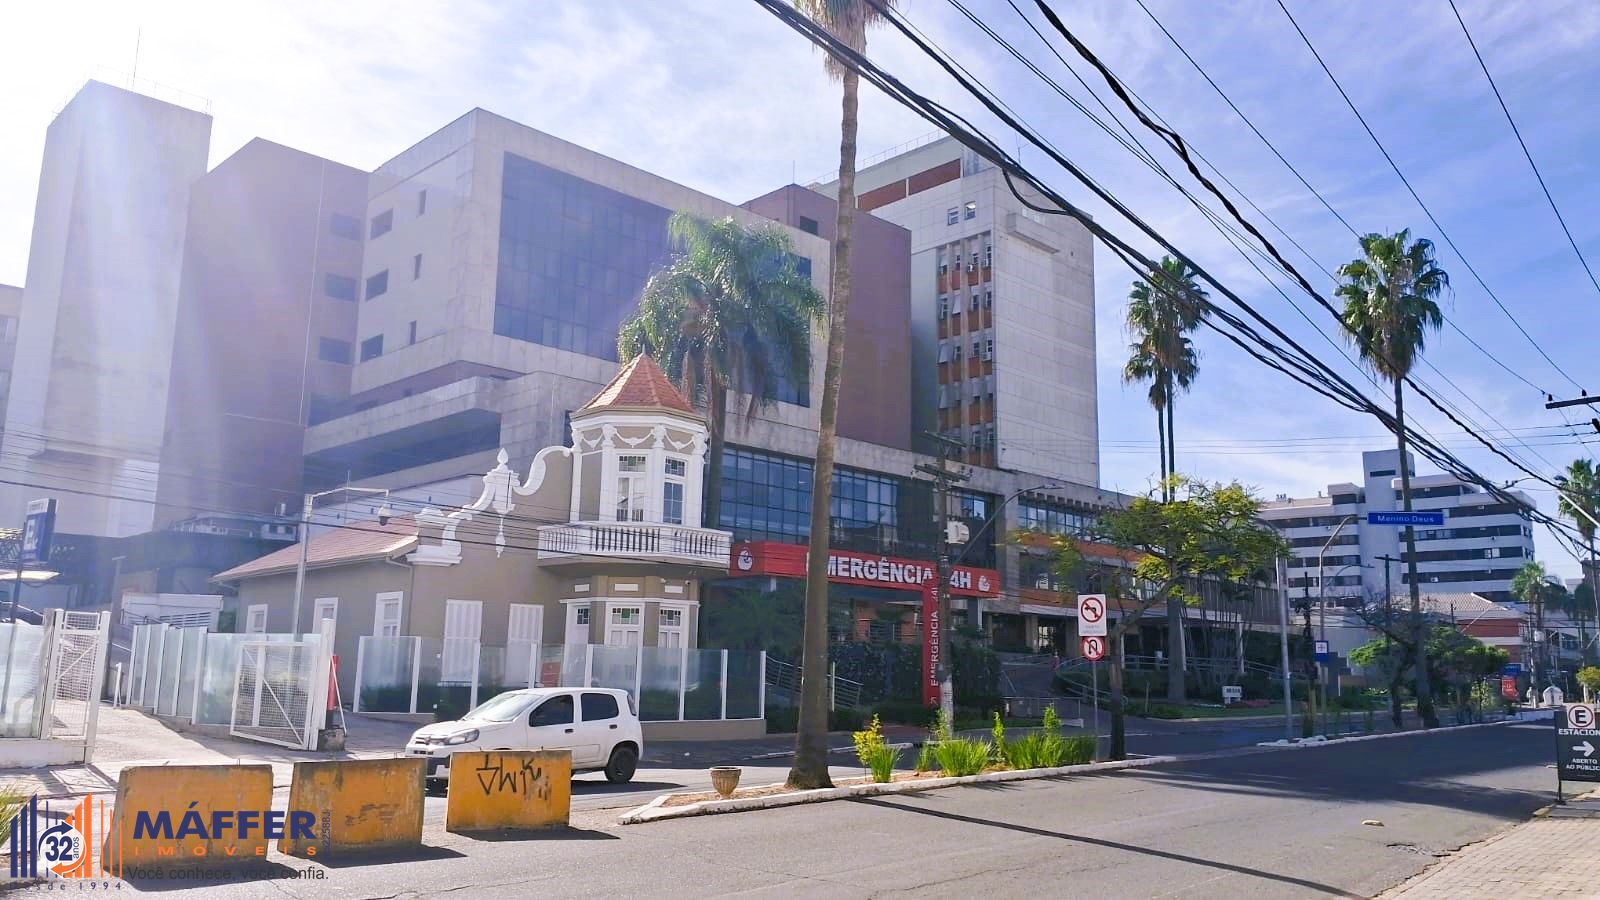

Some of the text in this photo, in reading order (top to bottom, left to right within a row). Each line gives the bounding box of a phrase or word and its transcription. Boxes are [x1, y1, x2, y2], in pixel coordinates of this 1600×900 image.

[1412, 515, 1435, 523] Deus
[806, 552, 972, 590] MERGÊNCIA 4H
[1575, 710, 1587, 724] E
